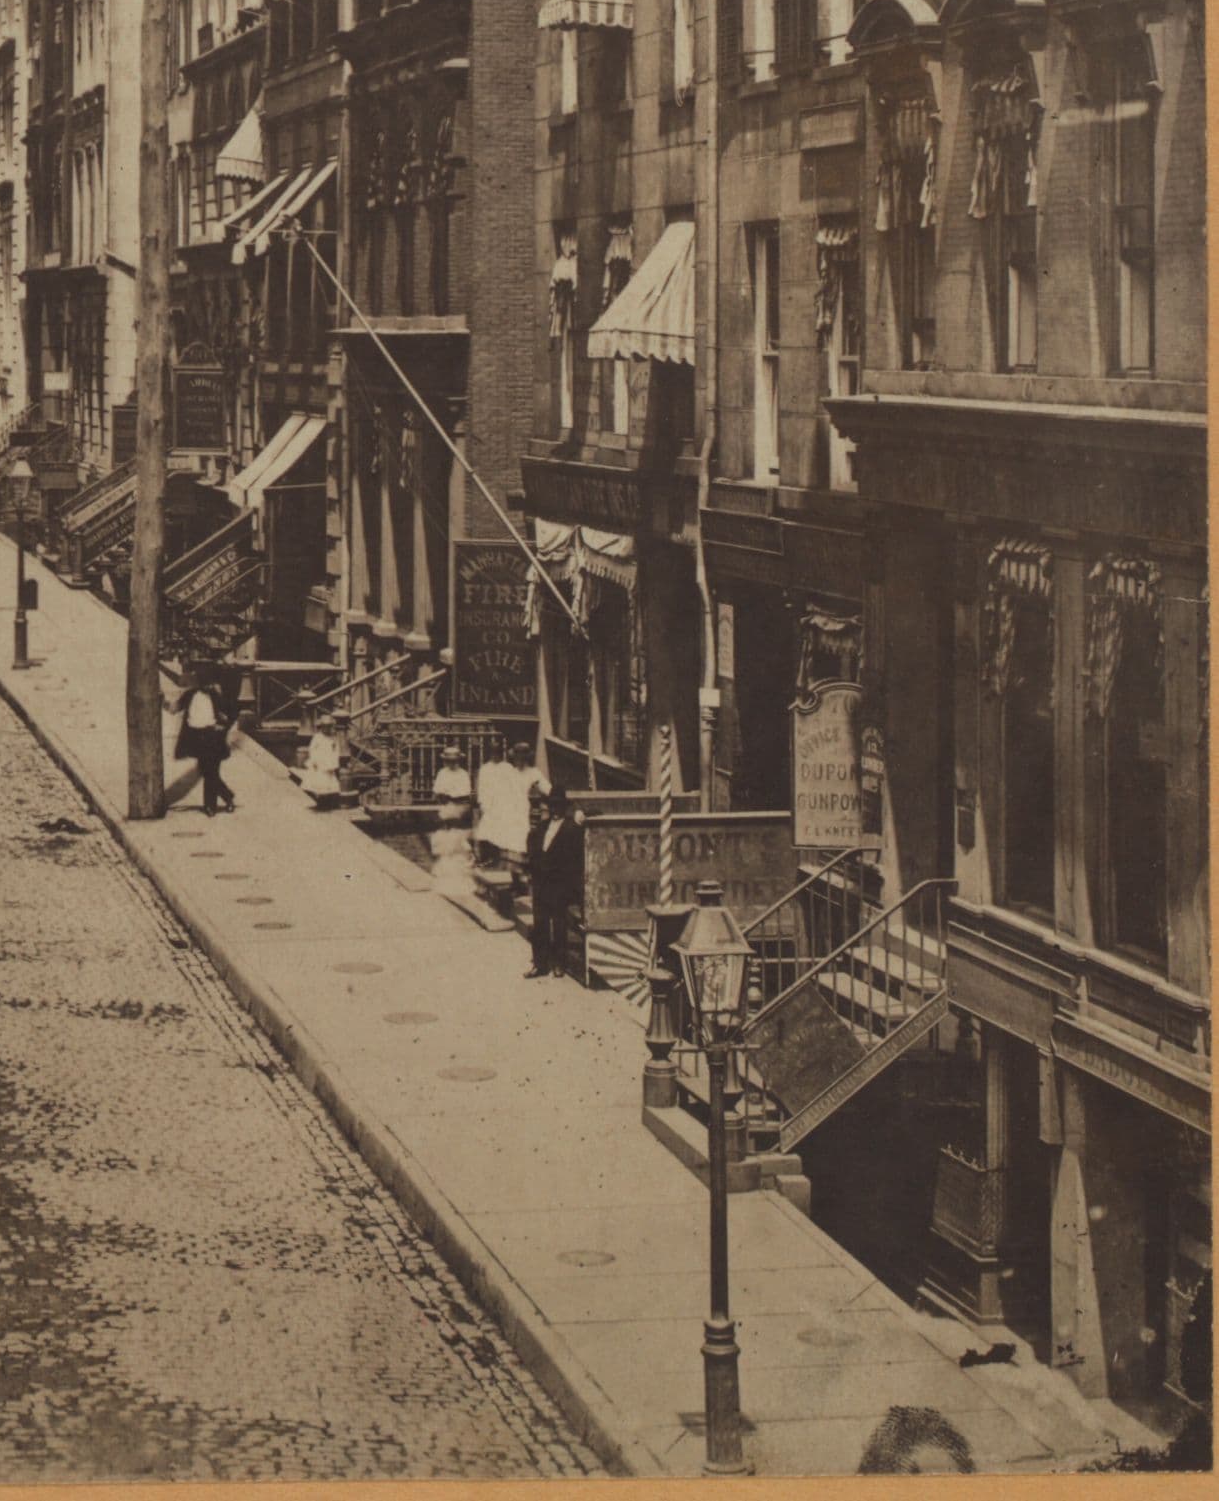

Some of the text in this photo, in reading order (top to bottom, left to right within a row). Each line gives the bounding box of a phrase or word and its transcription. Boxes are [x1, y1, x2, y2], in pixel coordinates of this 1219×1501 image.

[463, 584, 528, 606] FIRE
[468, 649, 524, 674] FIRE
[459, 681, 536, 706] INLAND
